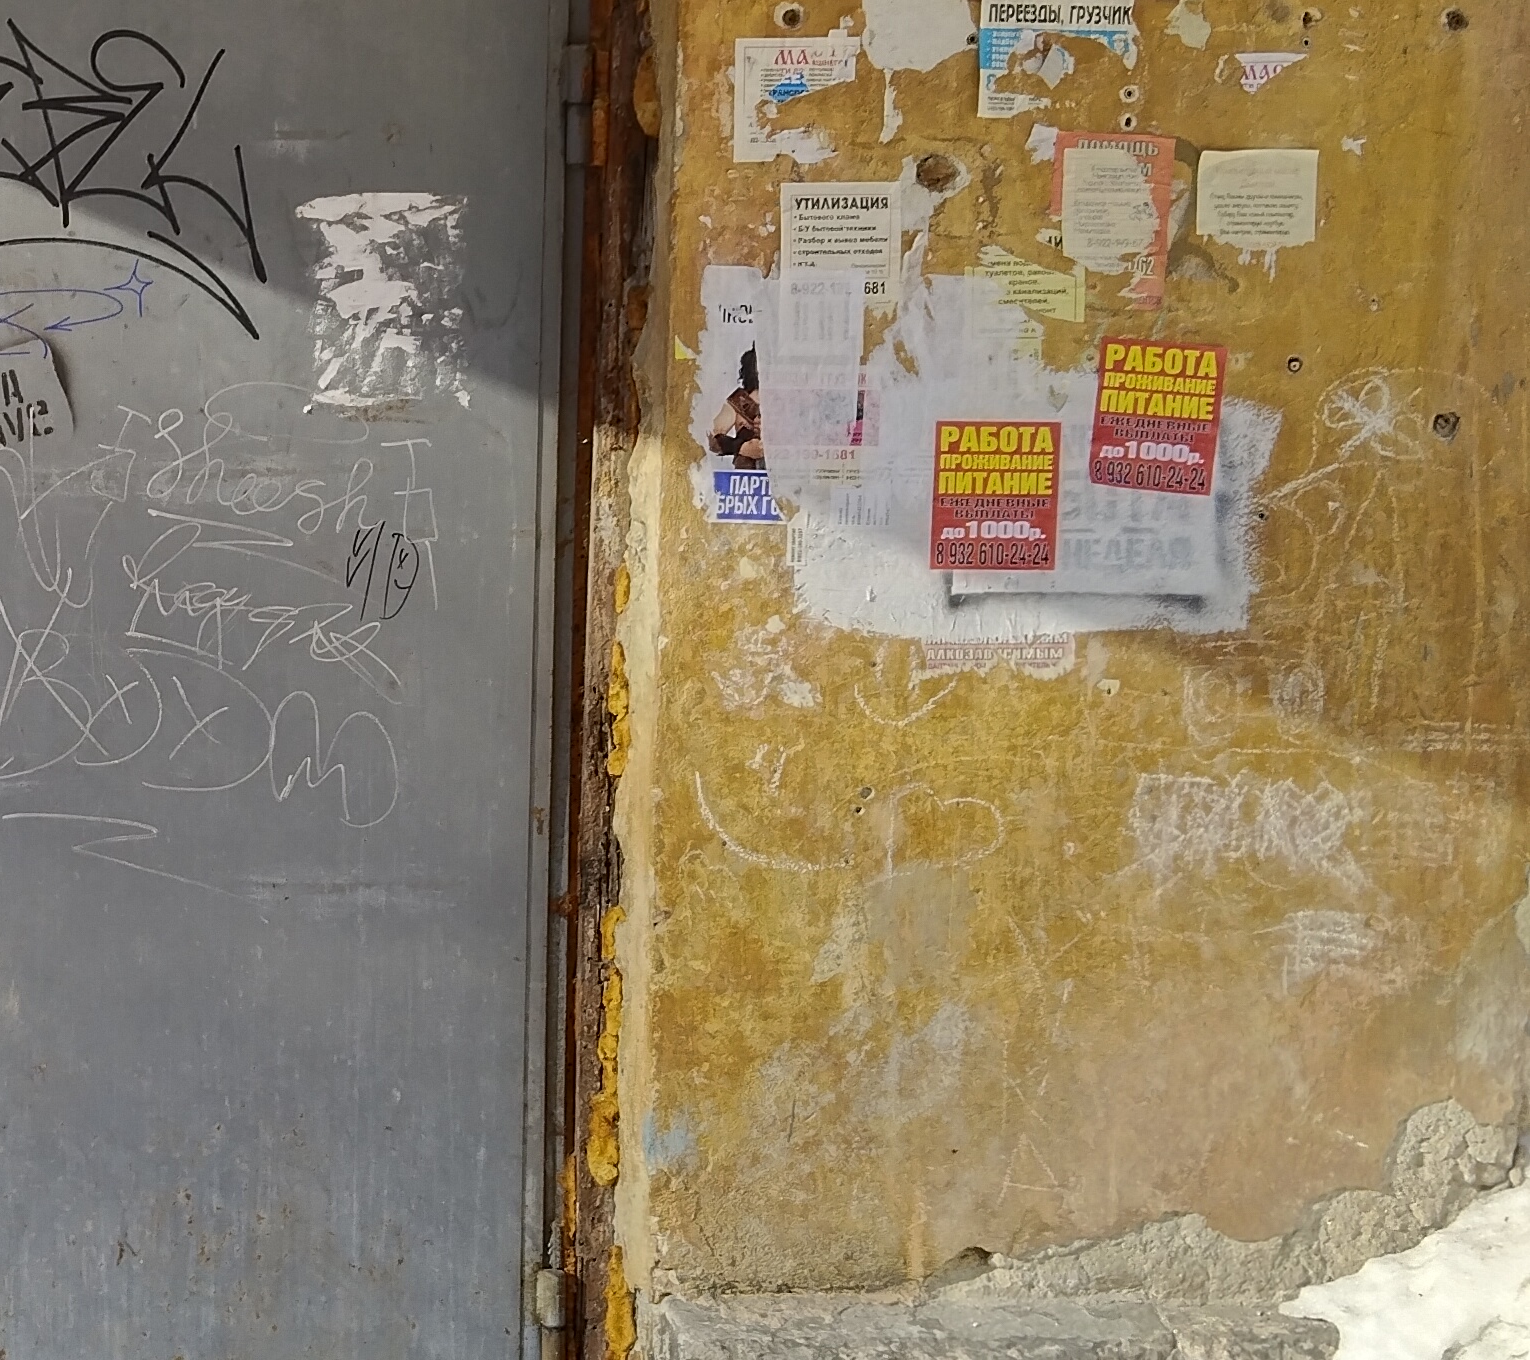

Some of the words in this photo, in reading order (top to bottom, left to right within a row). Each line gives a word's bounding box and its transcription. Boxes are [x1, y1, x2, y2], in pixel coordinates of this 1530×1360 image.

[988, 3, 1065, 26] ПЕРЕЕЗДЫ,
[794, 196, 889, 212] УТИЛИЗАЦИЯ
[1104, 343, 1218, 378] РАБОТА
[1103, 371, 1217, 396] ПРОЖИВАНИЕ
[1099, 389, 1215, 421] ПИТАНИЕ
[940, 425, 1054, 453] РАБОТА
[939, 454, 1054, 470] ПРОЖИВАНИЕ
[1099, 445, 1125, 459] до
[1124, 440, 1205, 466] 1000р.
[729, 475, 771, 496] ПАРТ
[938, 471, 1054, 496] ПИТАНИЕ
[1094, 459, 1103, 482] 8
[1106, 460, 1133, 485] 932
[1135, 463, 1206, 491] 610-24-24
[939, 496, 1050, 509] ЕЖЕДНЕВНЫЕ
[954, 508, 1035, 520] ВЫПЛАТЫ
[940, 526, 966, 540] до
[965, 520, 1047, 542] 1000р.
[936, 542, 945, 566] 8
[949, 542, 975, 566] 932
[978, 542, 1050, 566] 610-24-24
